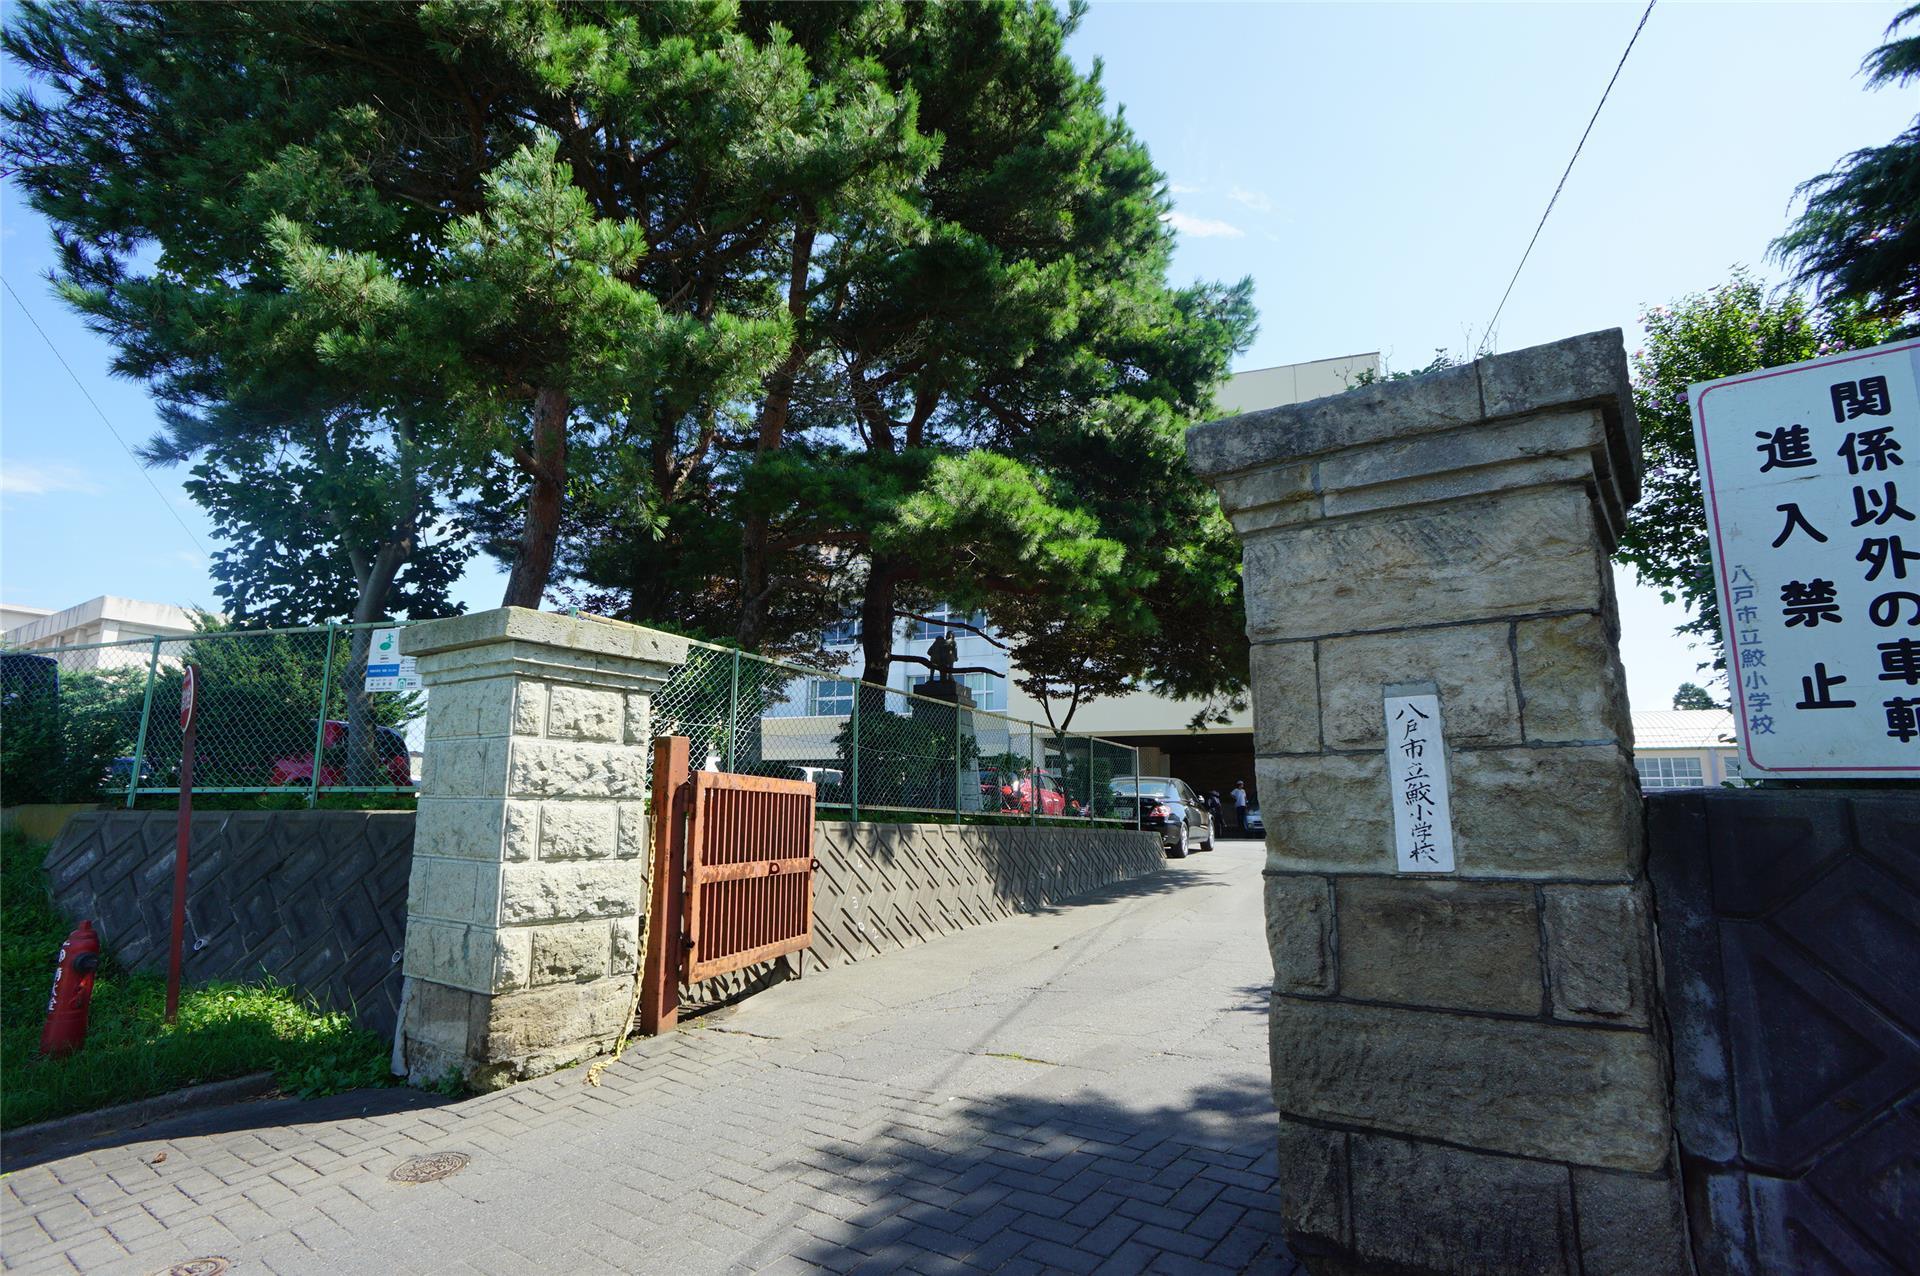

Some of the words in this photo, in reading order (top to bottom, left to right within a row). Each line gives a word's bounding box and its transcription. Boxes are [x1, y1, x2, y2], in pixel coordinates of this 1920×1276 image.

[1731, 565, 1776, 735] 八戸市立鮫小学校
[1755, 424, 1857, 710] 進入禁止
[1396, 703, 1439, 864] 八戸市立鮫小学校
